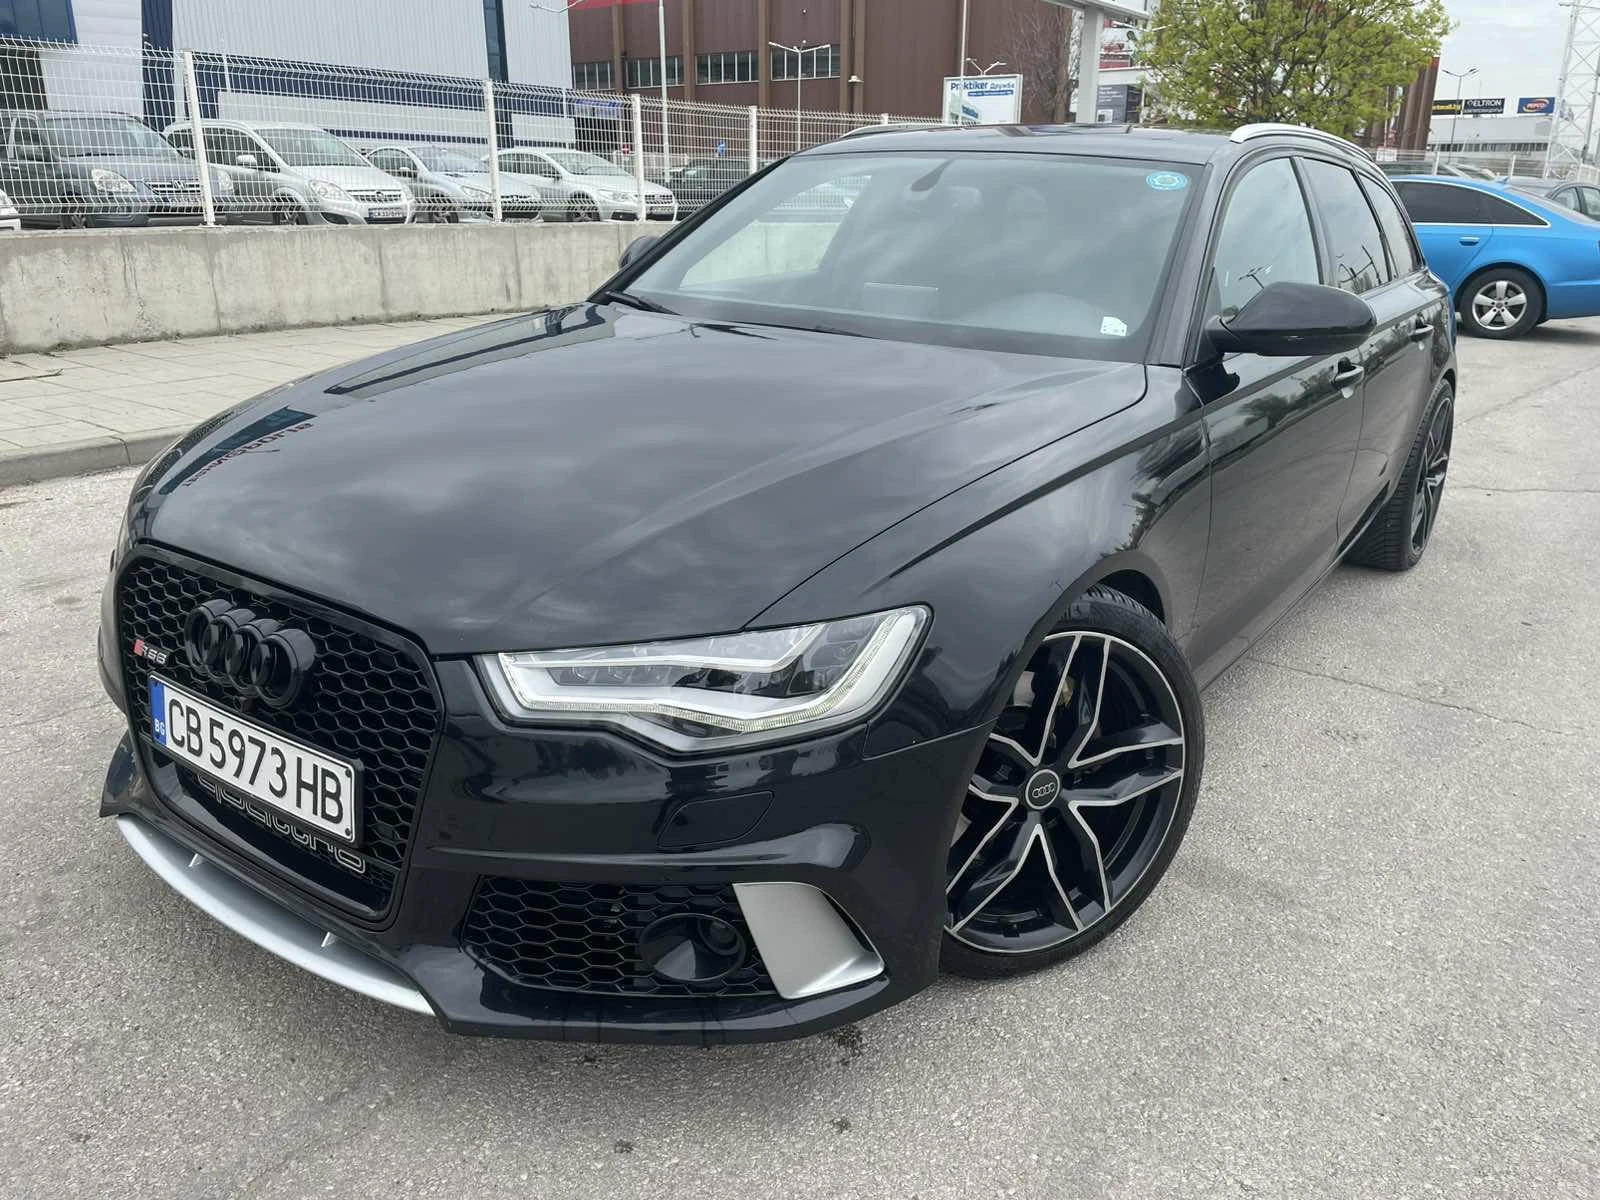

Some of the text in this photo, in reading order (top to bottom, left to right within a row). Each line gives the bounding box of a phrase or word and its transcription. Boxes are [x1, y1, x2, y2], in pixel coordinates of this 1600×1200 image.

[950, 80, 988, 91] Prktiker
[140, 643, 167, 665] RS6
[154, 718, 166, 736] BG
[168, 698, 344, 825] CB 5973 HB
